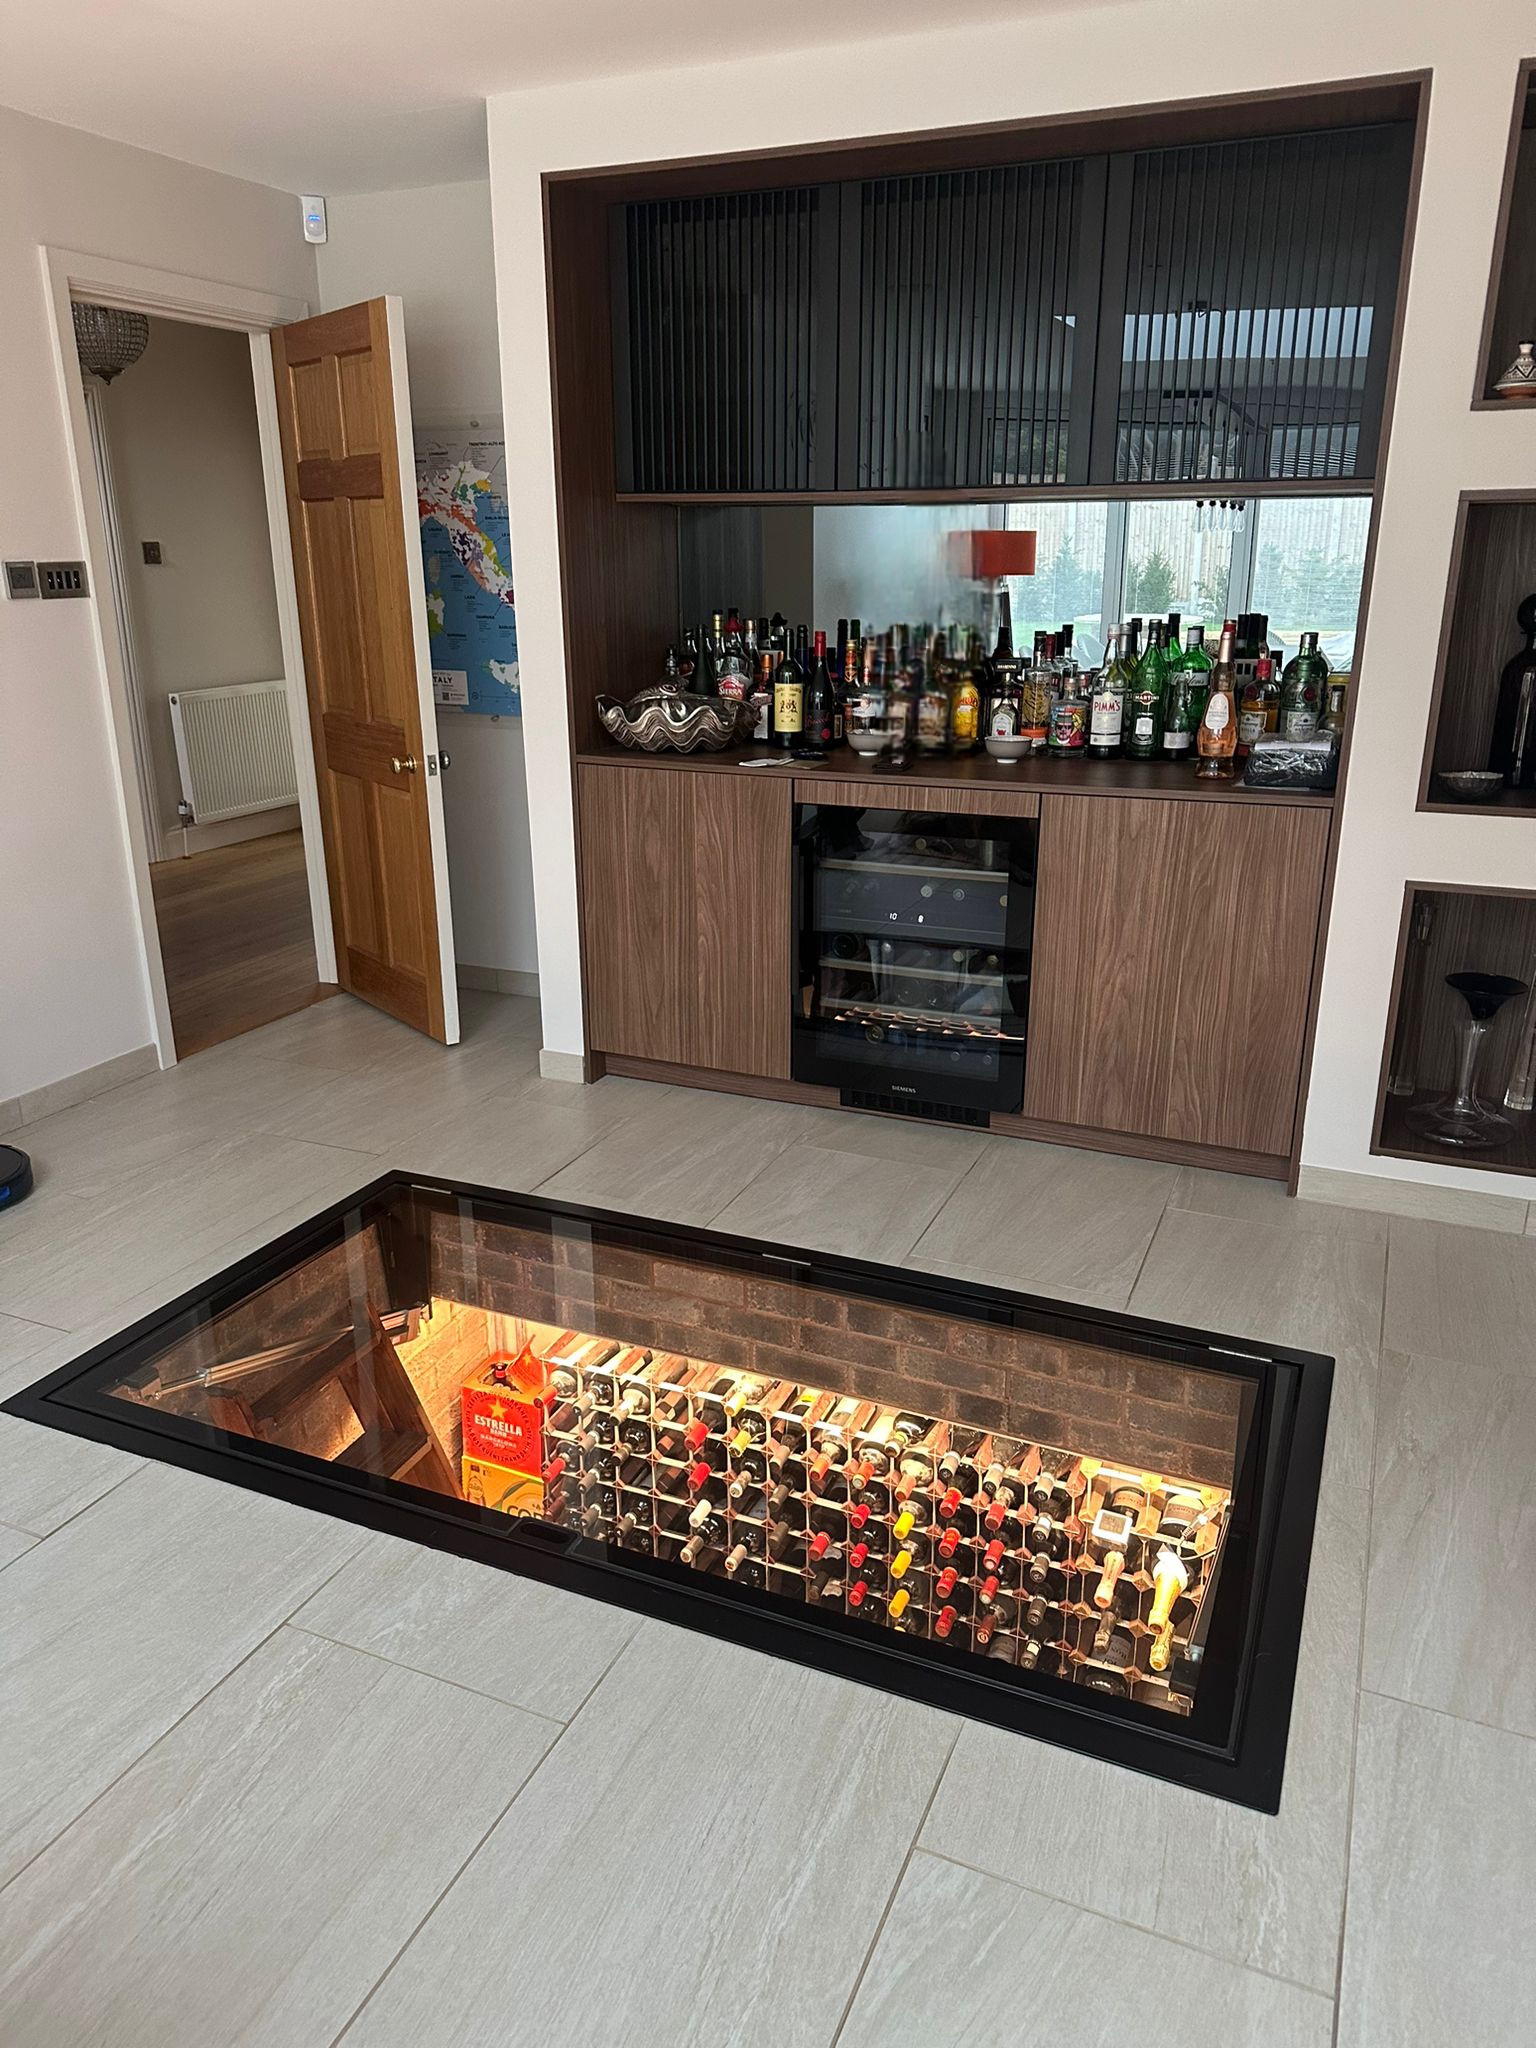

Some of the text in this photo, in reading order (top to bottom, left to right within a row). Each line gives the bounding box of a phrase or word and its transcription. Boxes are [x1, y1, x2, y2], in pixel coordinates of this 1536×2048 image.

[432, 676, 453, 684] TALY
[718, 687, 744, 697] SIERRA
[1094, 700, 1121, 712] PIMM'S
[889, 912, 898, 920] 10
[891, 1085, 917, 1093] SIEMENS
[474, 1414, 523, 1437] ESTRELLA
